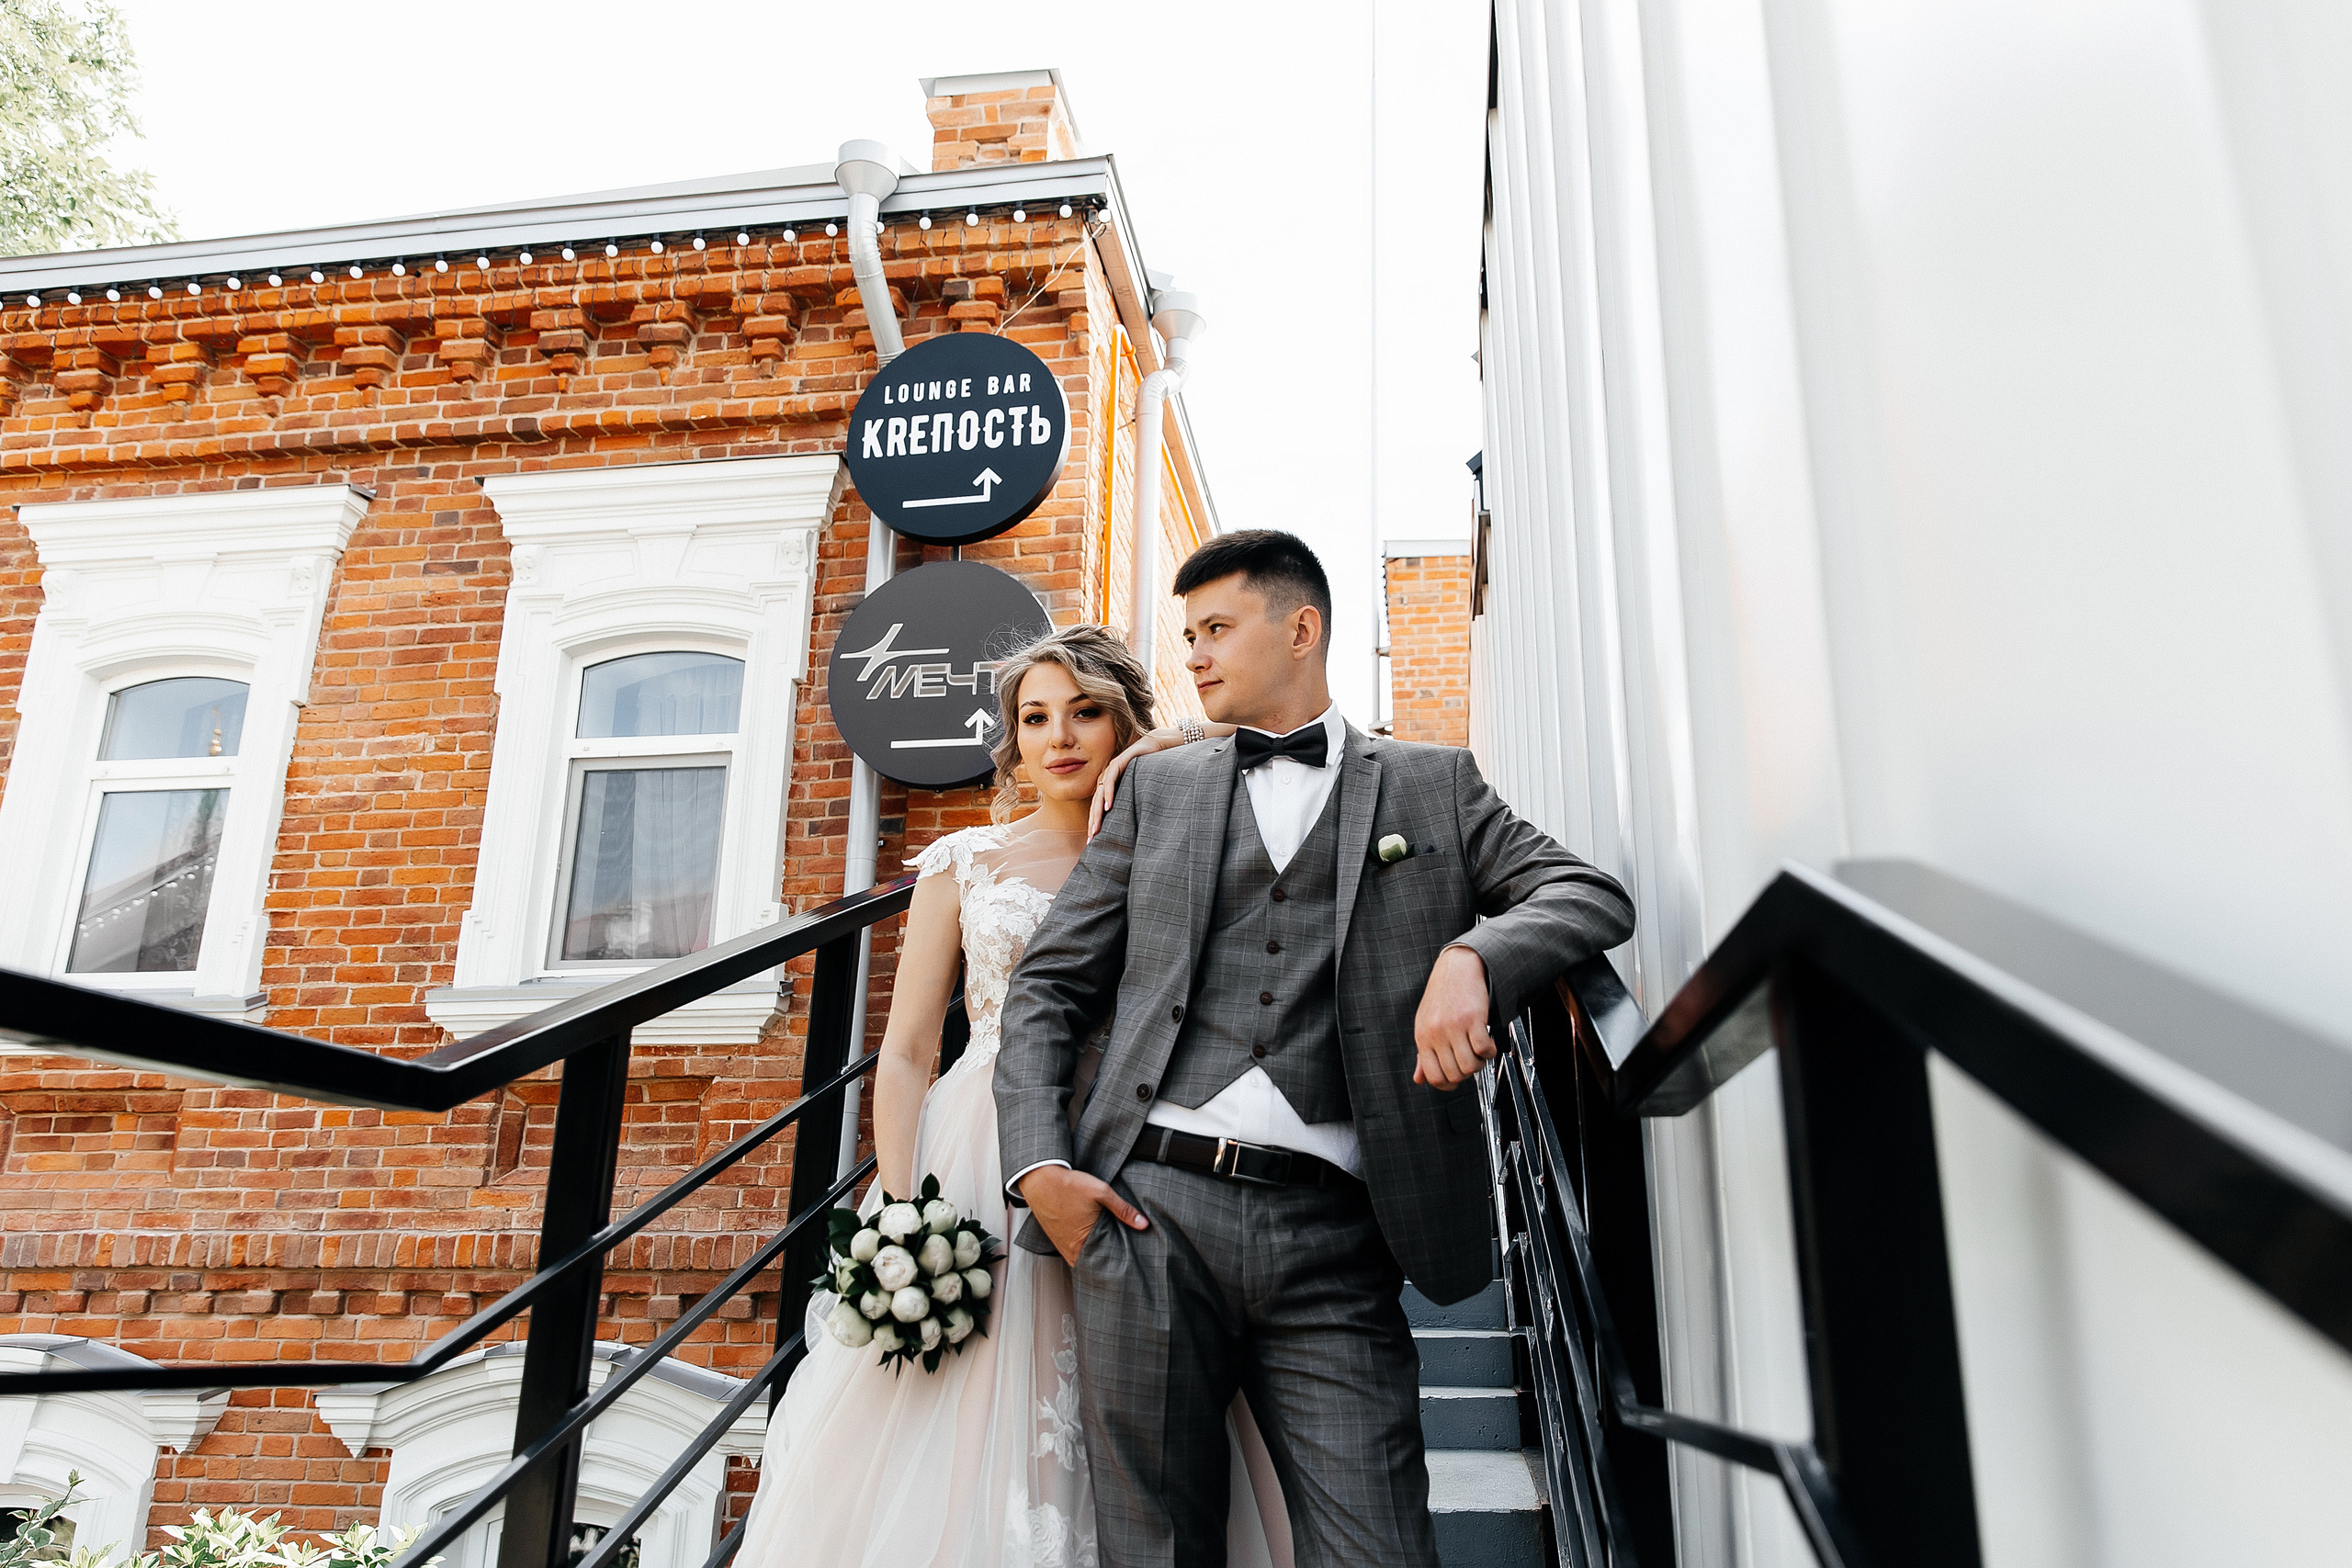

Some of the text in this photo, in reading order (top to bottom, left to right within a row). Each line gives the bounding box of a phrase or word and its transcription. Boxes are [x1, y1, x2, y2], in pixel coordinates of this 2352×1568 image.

[884, 373, 1031, 404] LOUNGE BAR
[865, 661, 1007, 700] МЕЧТ
